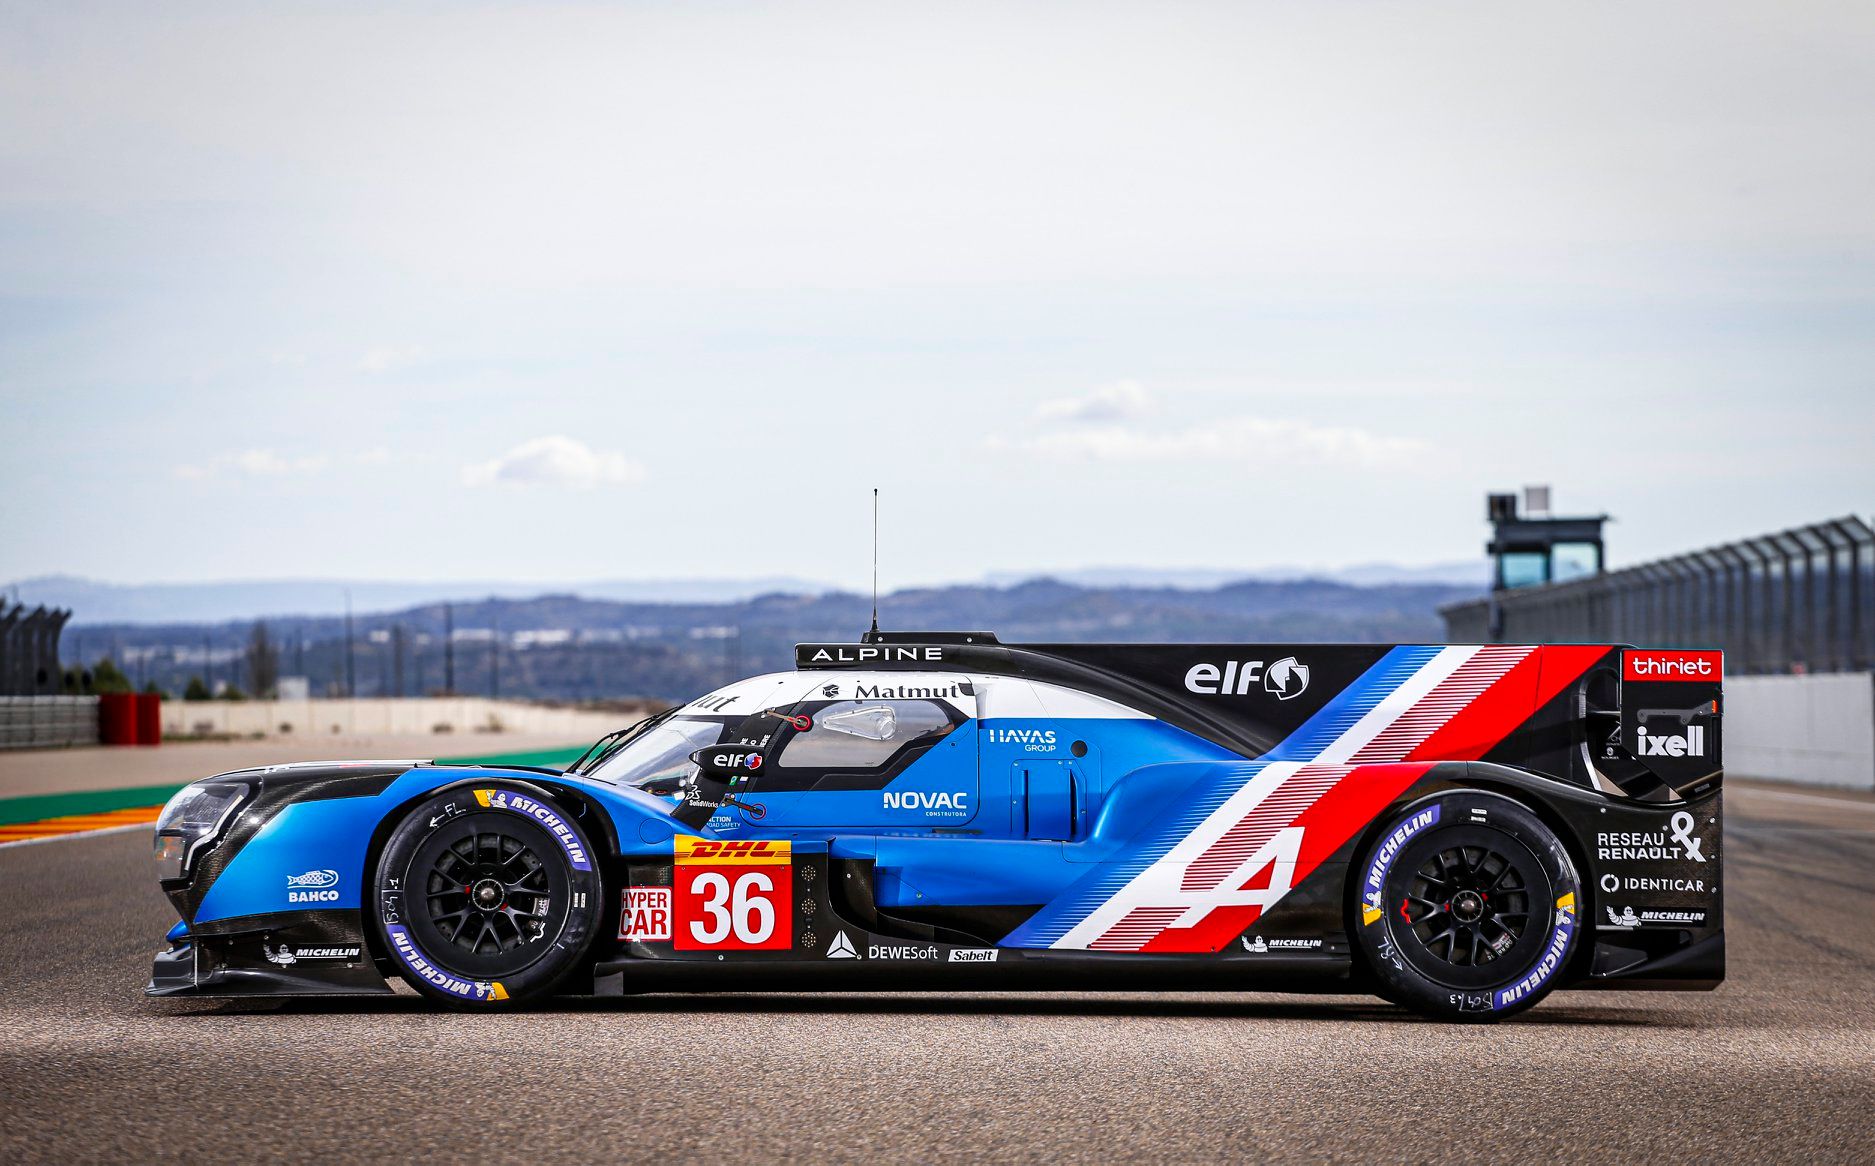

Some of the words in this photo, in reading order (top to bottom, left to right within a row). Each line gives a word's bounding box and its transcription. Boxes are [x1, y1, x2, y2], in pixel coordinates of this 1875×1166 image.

[811, 647, 943, 661] ALPINE
[1632, 657, 1712, 675] thiriet
[1184, 660, 1264, 695] elf
[855, 684, 960, 699] Matmut
[989, 730, 1056, 744] HAVAS
[1637, 725, 1704, 758] ixell
[1024, 744, 1056, 753] GROUP
[713, 753, 744, 767] elf
[883, 792, 967, 809] NOVAC
[510, 796, 586, 864] MICHELIN
[1598, 832, 1664, 847] RESEAU
[689, 841, 776, 858] DHL
[1368, 810, 1433, 888] MICHELIN
[1598, 847, 1682, 860] RENAULT
[1624, 878, 1704, 892] IDENTICAR
[289, 891, 339, 903] BAHCO
[622, 892, 667, 908] HYPER
[689, 872, 775, 945] 36
[1641, 911, 1705, 921] MICHELIN
[620, 909, 667, 935] CAR
[1268, 938, 1322, 947] MICHELIN
[296, 948, 360, 957] MICHELIN
[868, 946, 938, 959] DEWESoft
[953, 950, 993, 961] Sabelt
[391, 931, 472, 995] MICHELIN
[1502, 928, 1568, 1005] MICHELIN
